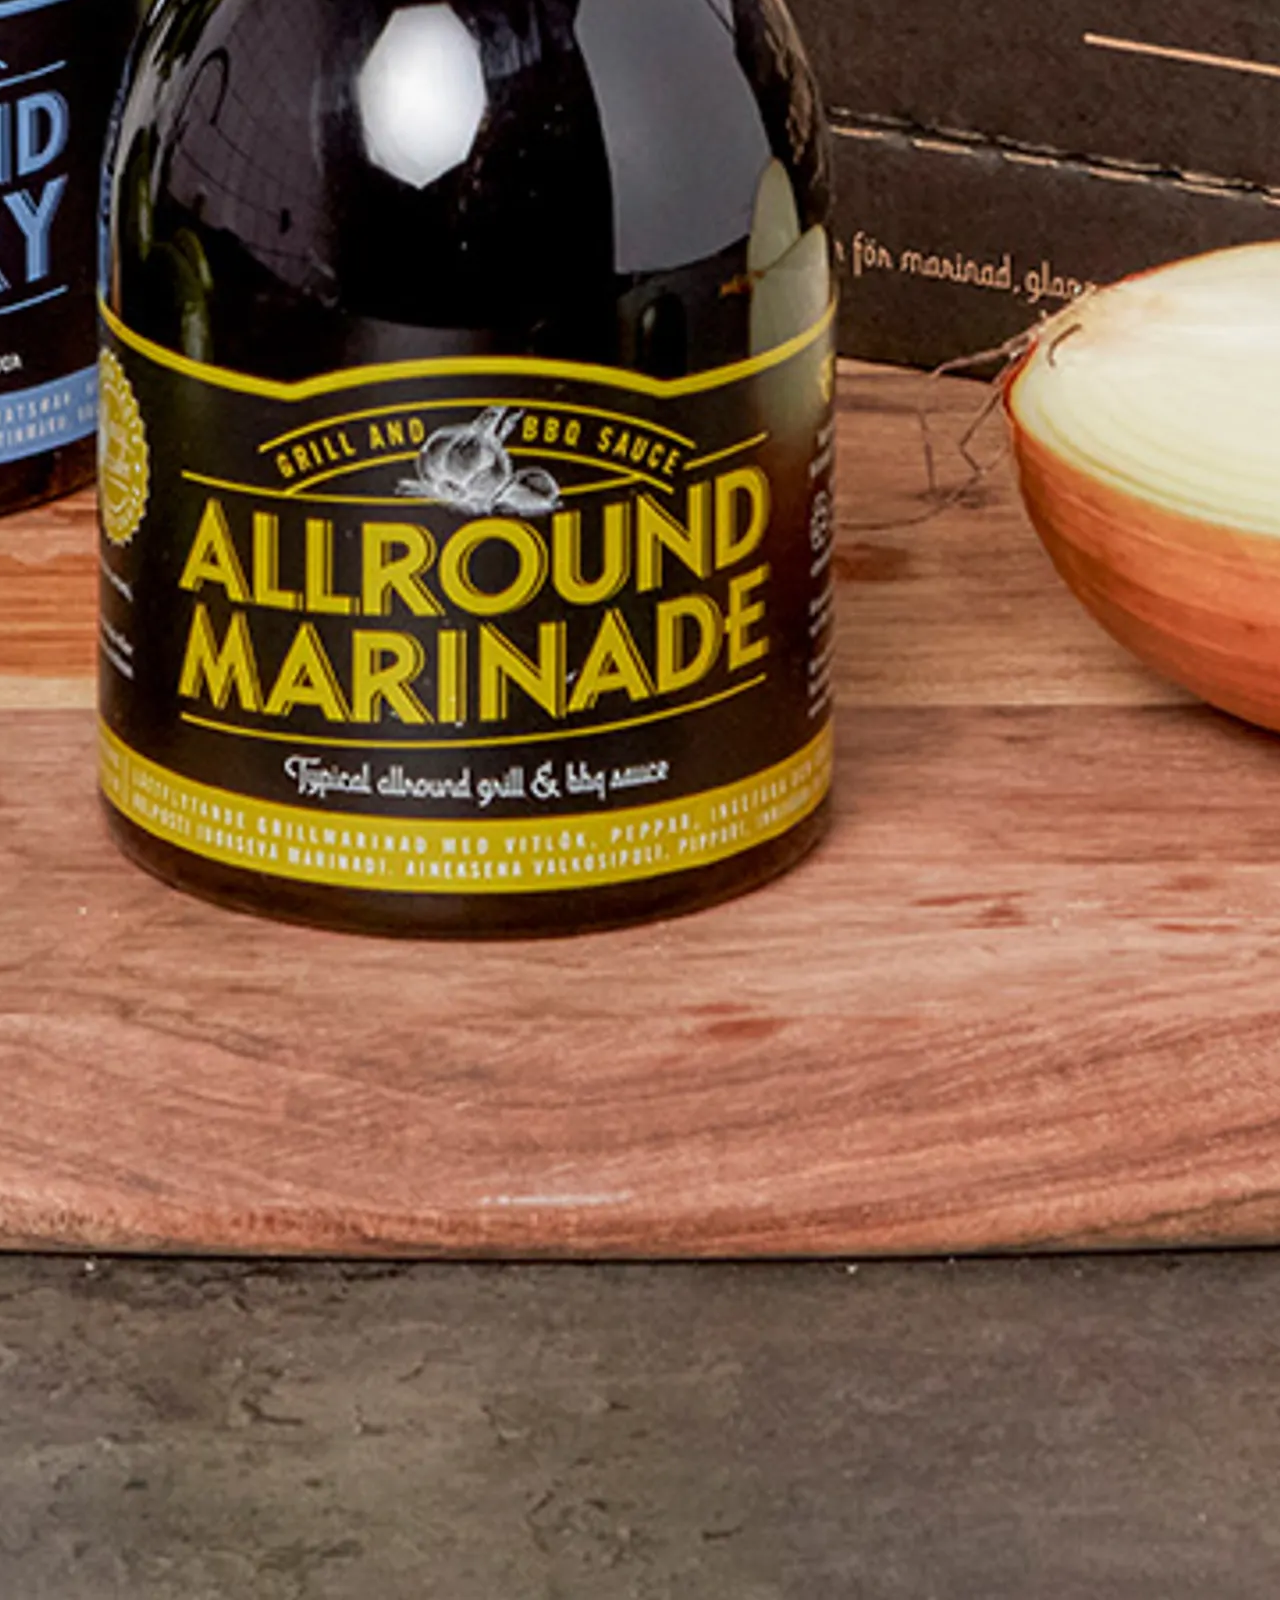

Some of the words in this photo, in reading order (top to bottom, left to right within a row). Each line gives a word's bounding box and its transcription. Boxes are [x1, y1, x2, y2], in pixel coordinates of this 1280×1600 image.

[852, 231, 893, 276] för
[276, 432, 356, 478] GRILL
[369, 418, 425, 449] AND
[522, 415, 580, 447] BBQ
[596, 426, 681, 476] SAUCE
[178, 465, 770, 618] ALLROUND
[178, 567, 770, 723] MARINADE
[284, 755, 370, 798] Typical
[377, 767, 472, 798] allround
[477, 765, 524, 808] grill
[530, 760, 561, 798] &
[566, 762, 605, 799] bbq
